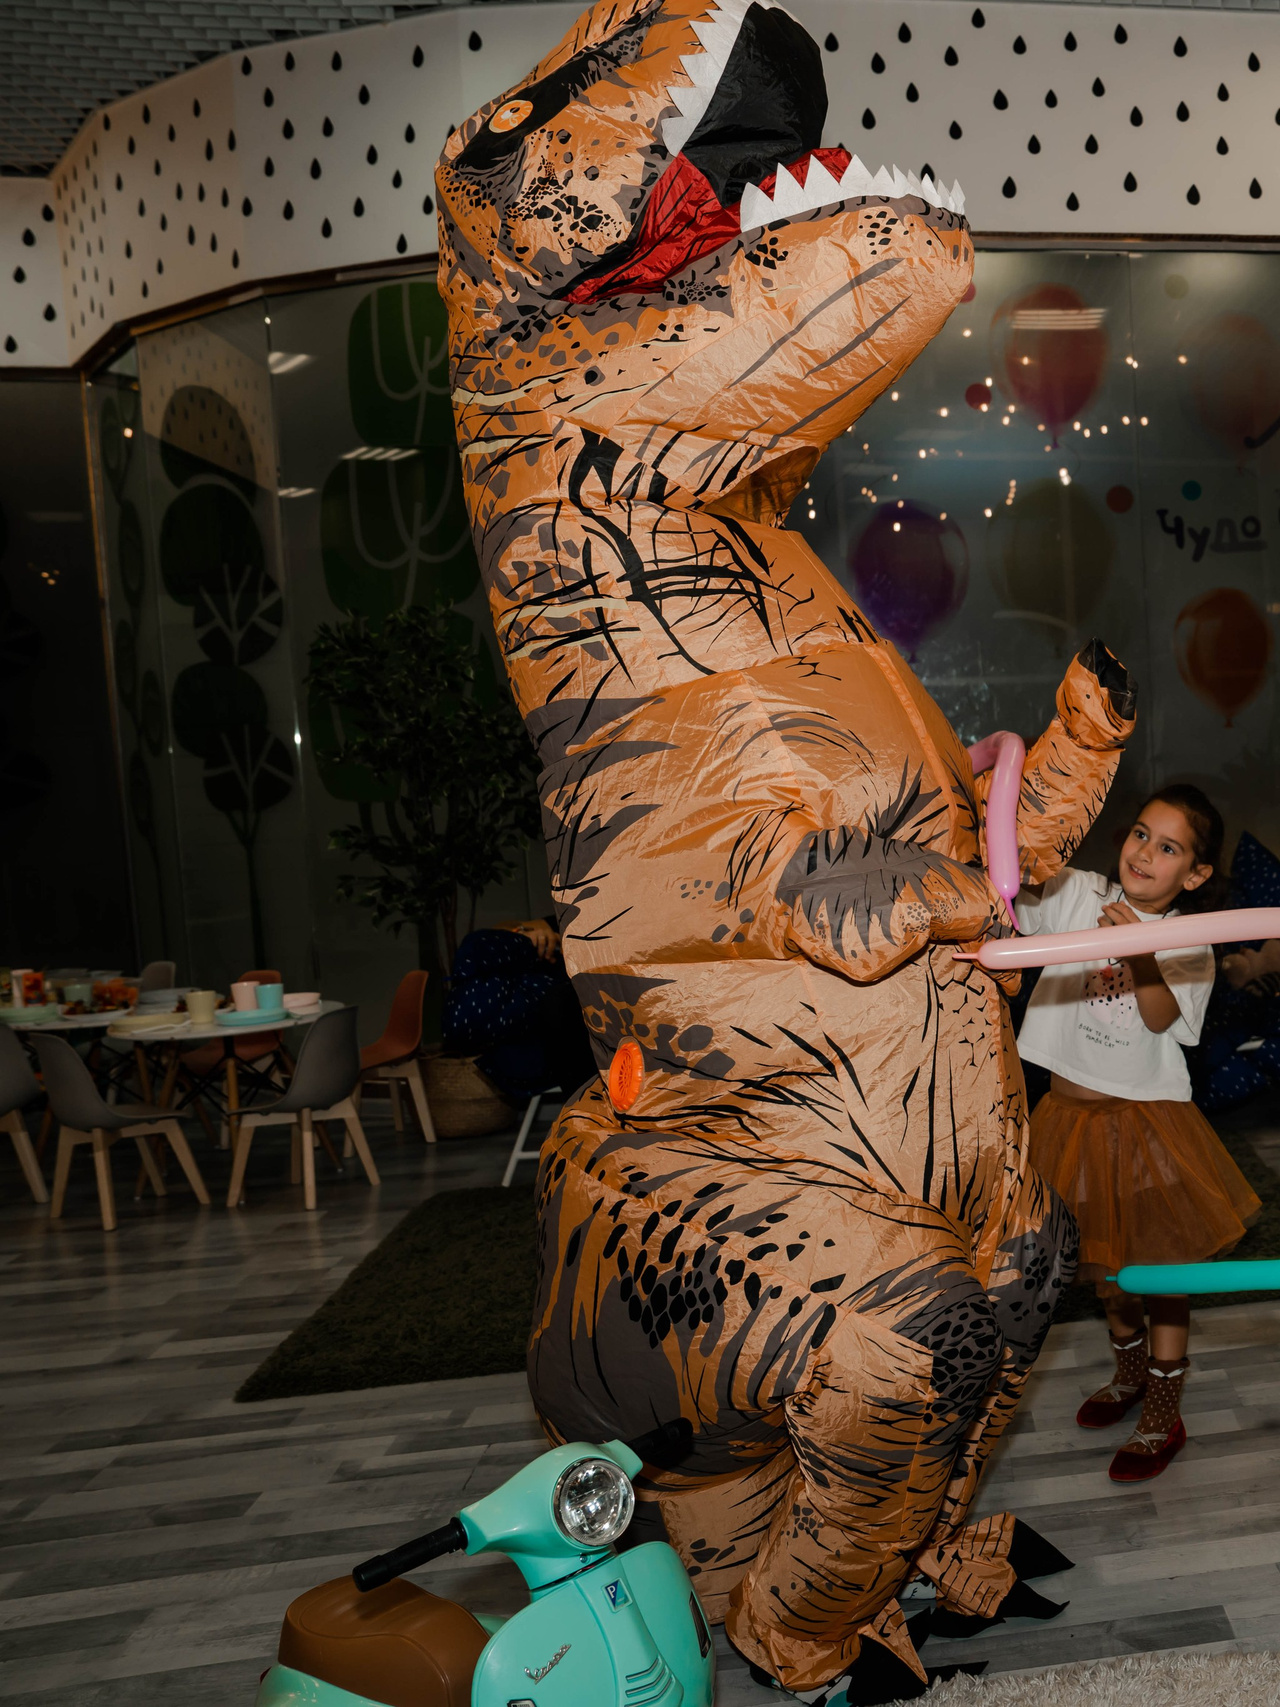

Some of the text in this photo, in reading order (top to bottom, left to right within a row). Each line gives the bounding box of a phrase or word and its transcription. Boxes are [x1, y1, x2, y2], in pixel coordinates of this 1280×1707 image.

[1155, 507, 1269, 563] Чудо
[1078, 1023, 1093, 1033] BORN
[1115, 1038, 1130, 1047] WILD
[1104, 1041, 1115, 1049] CAT
[607, 1585, 616, 1599] P
[524, 1643, 572, 1686] Vespa
